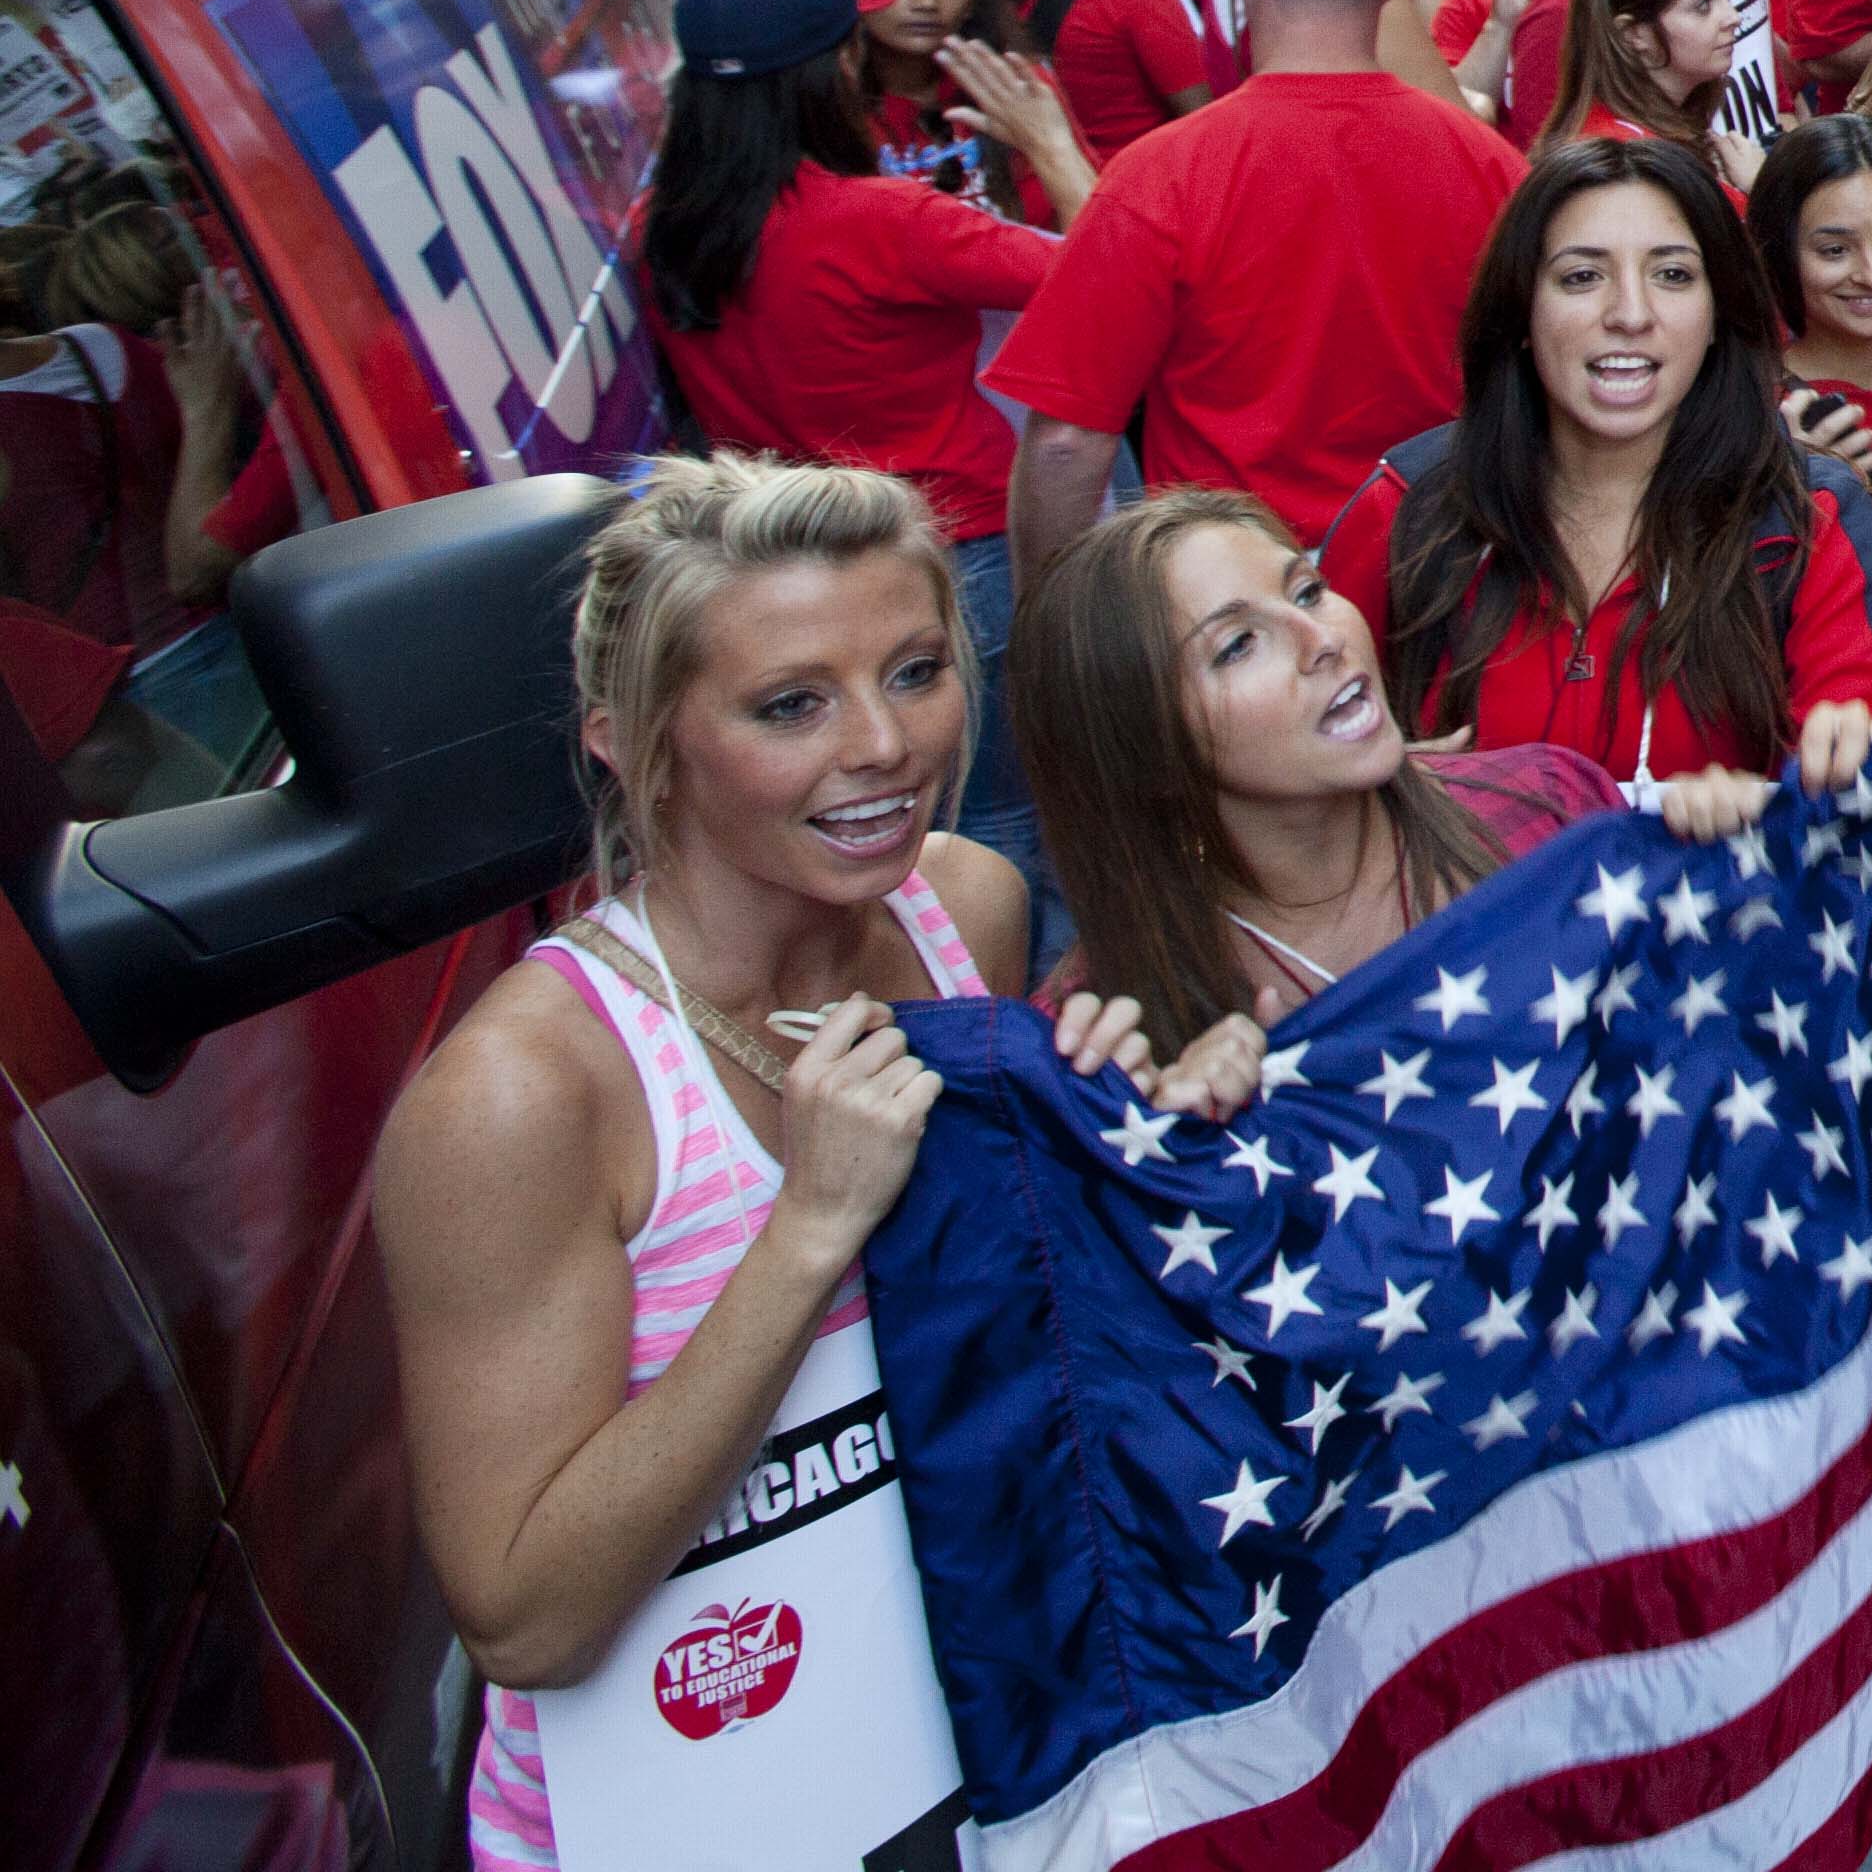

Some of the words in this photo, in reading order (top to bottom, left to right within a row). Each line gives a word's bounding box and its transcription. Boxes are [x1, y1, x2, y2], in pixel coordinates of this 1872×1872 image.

[332, 21, 638, 486] FOX
[659, 1683, 683, 1705] TO
[685, 1640, 798, 1697] EDUCATIONAL
[661, 1632, 734, 1684] YES
[697, 1669, 766, 1709] JUSTICE
